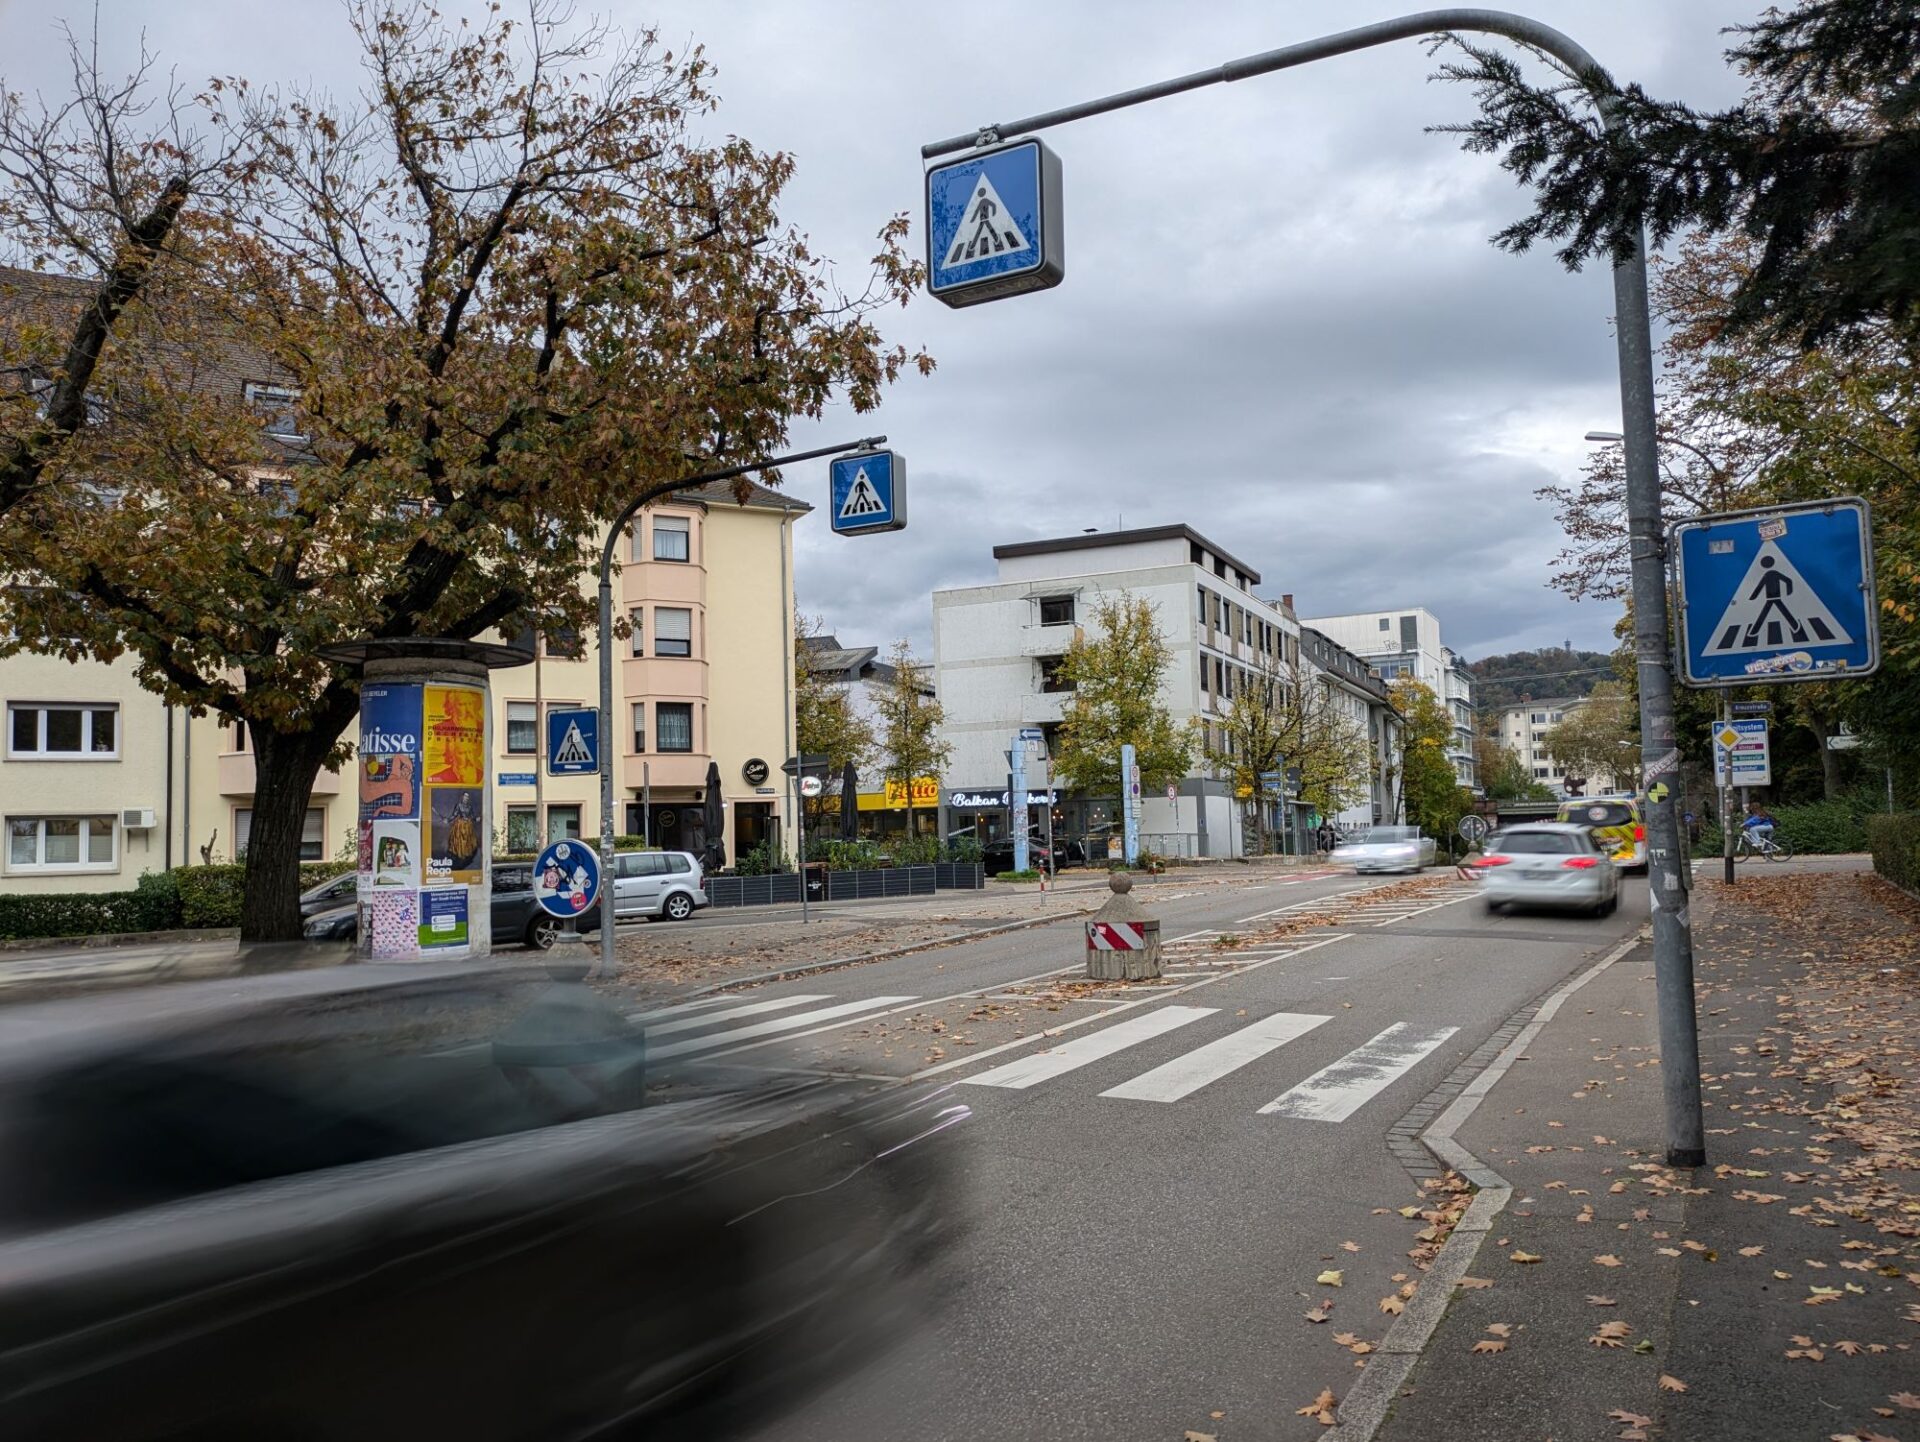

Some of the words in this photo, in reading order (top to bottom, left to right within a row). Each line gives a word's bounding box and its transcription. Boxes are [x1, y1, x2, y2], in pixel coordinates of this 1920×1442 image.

[951, 793, 999, 807] Balkan
[426, 857, 453, 867] Paula
[426, 867, 452, 877] Rego
